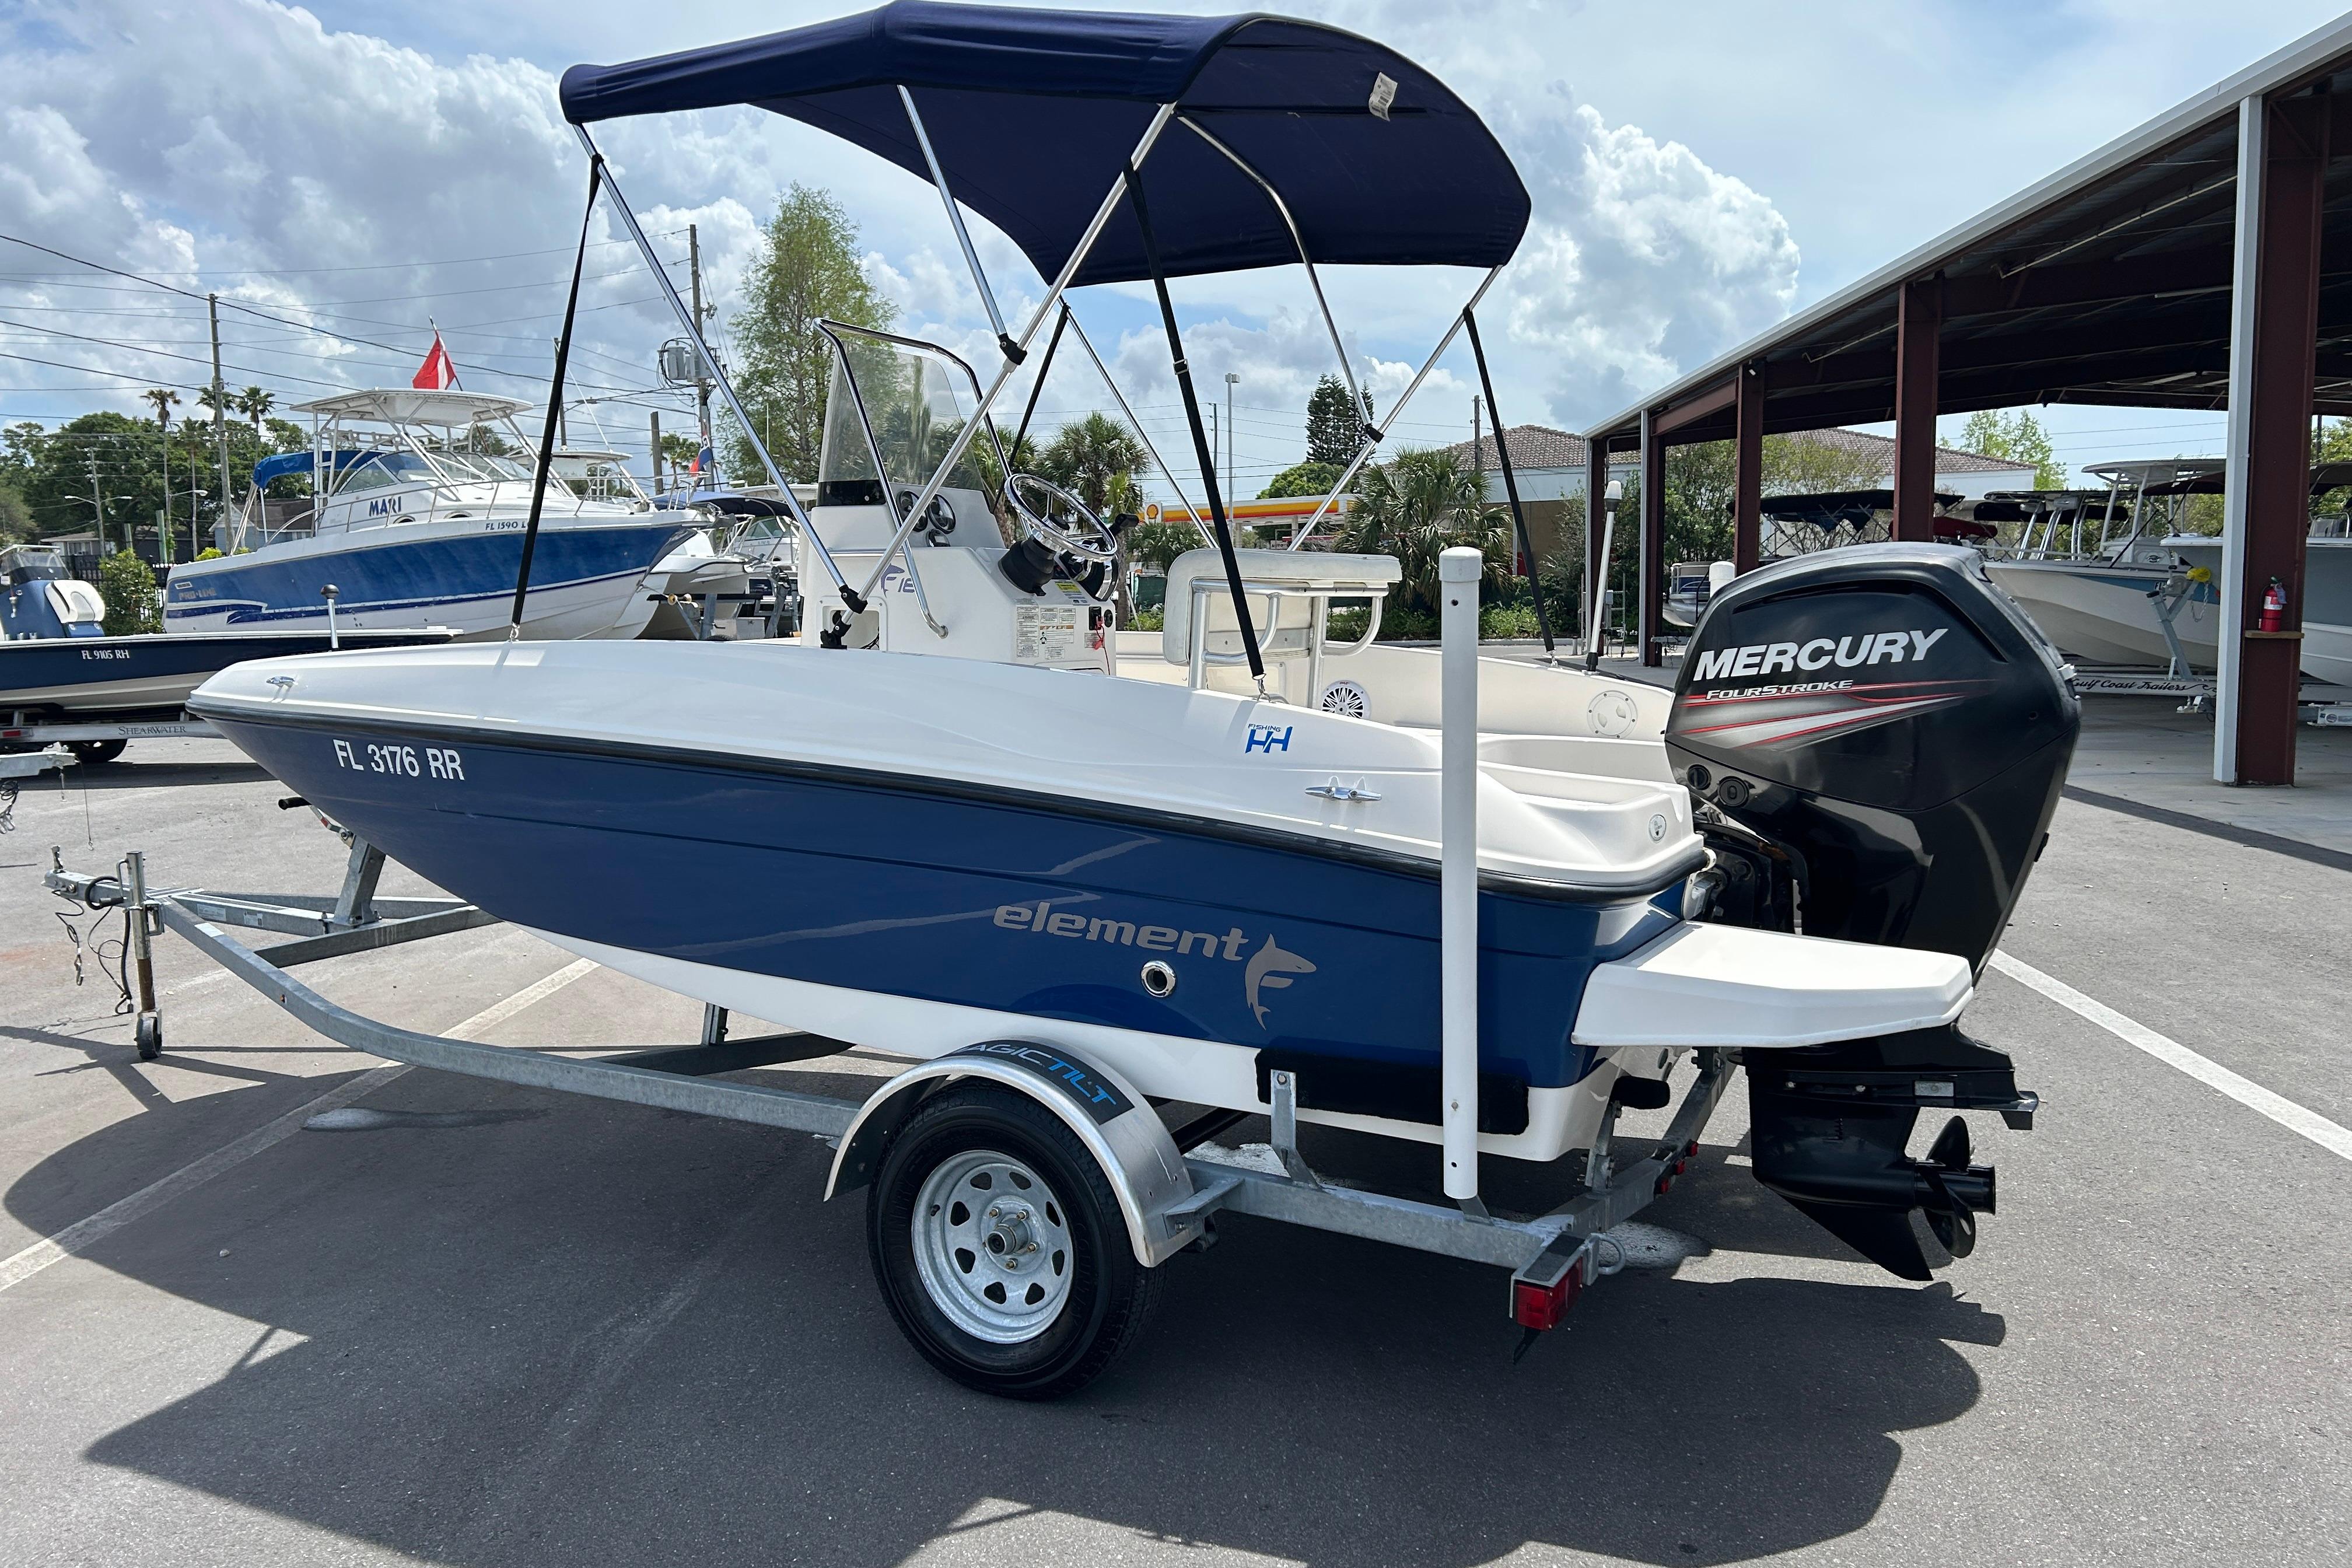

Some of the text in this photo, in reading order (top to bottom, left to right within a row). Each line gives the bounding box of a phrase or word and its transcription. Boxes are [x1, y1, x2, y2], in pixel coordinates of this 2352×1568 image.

[498, 522, 518, 530] 1590
[82, 649, 130, 659] FL 9105 RH
[1693, 628, 1949, 681] MERCURY
[2101, 680, 2135, 689] Coast
[2136, 681, 2190, 691] Trailers
[1248, 723, 1282, 733] FISHING
[1245, 726, 1293, 754] HH
[332, 739, 466, 781] FL 3176 RR
[993, 901, 1250, 961] element
